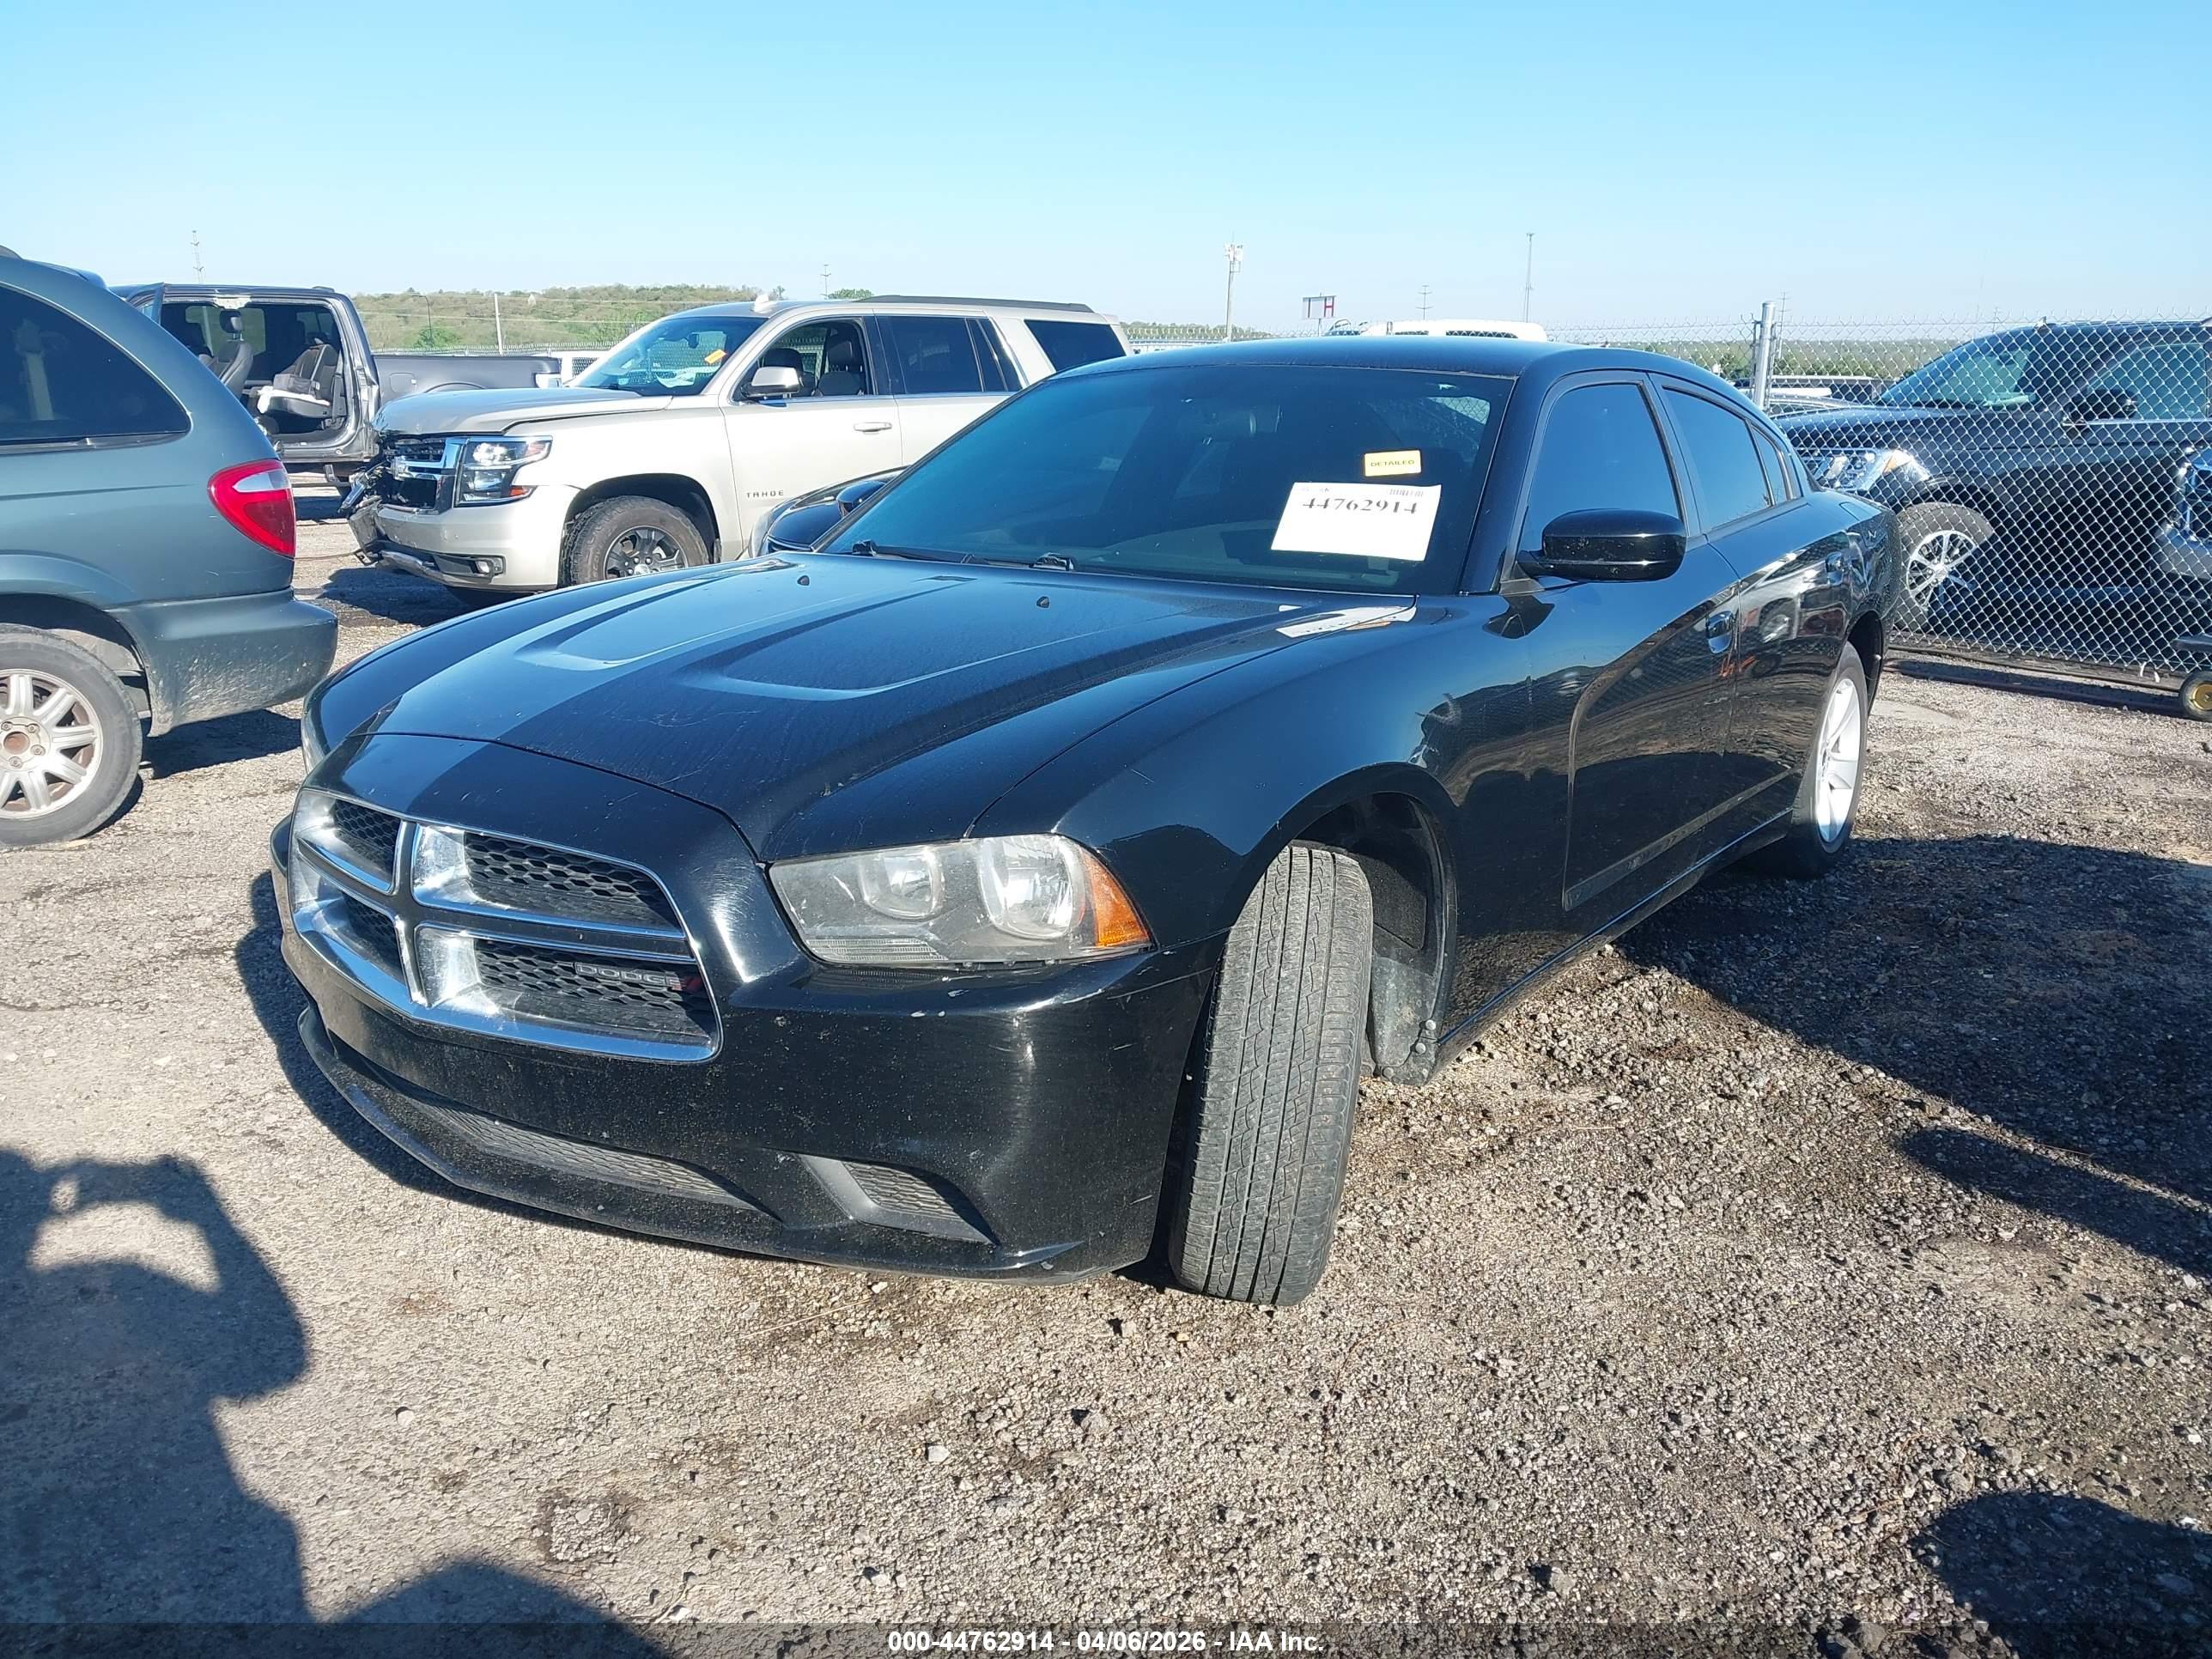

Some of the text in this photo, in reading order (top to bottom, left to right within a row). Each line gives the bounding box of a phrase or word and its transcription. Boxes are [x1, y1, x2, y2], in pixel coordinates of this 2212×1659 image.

[746, 489, 784, 498] TAHOE
[1302, 497, 1418, 514] 44762914
[576, 963, 681, 988] DODGE
